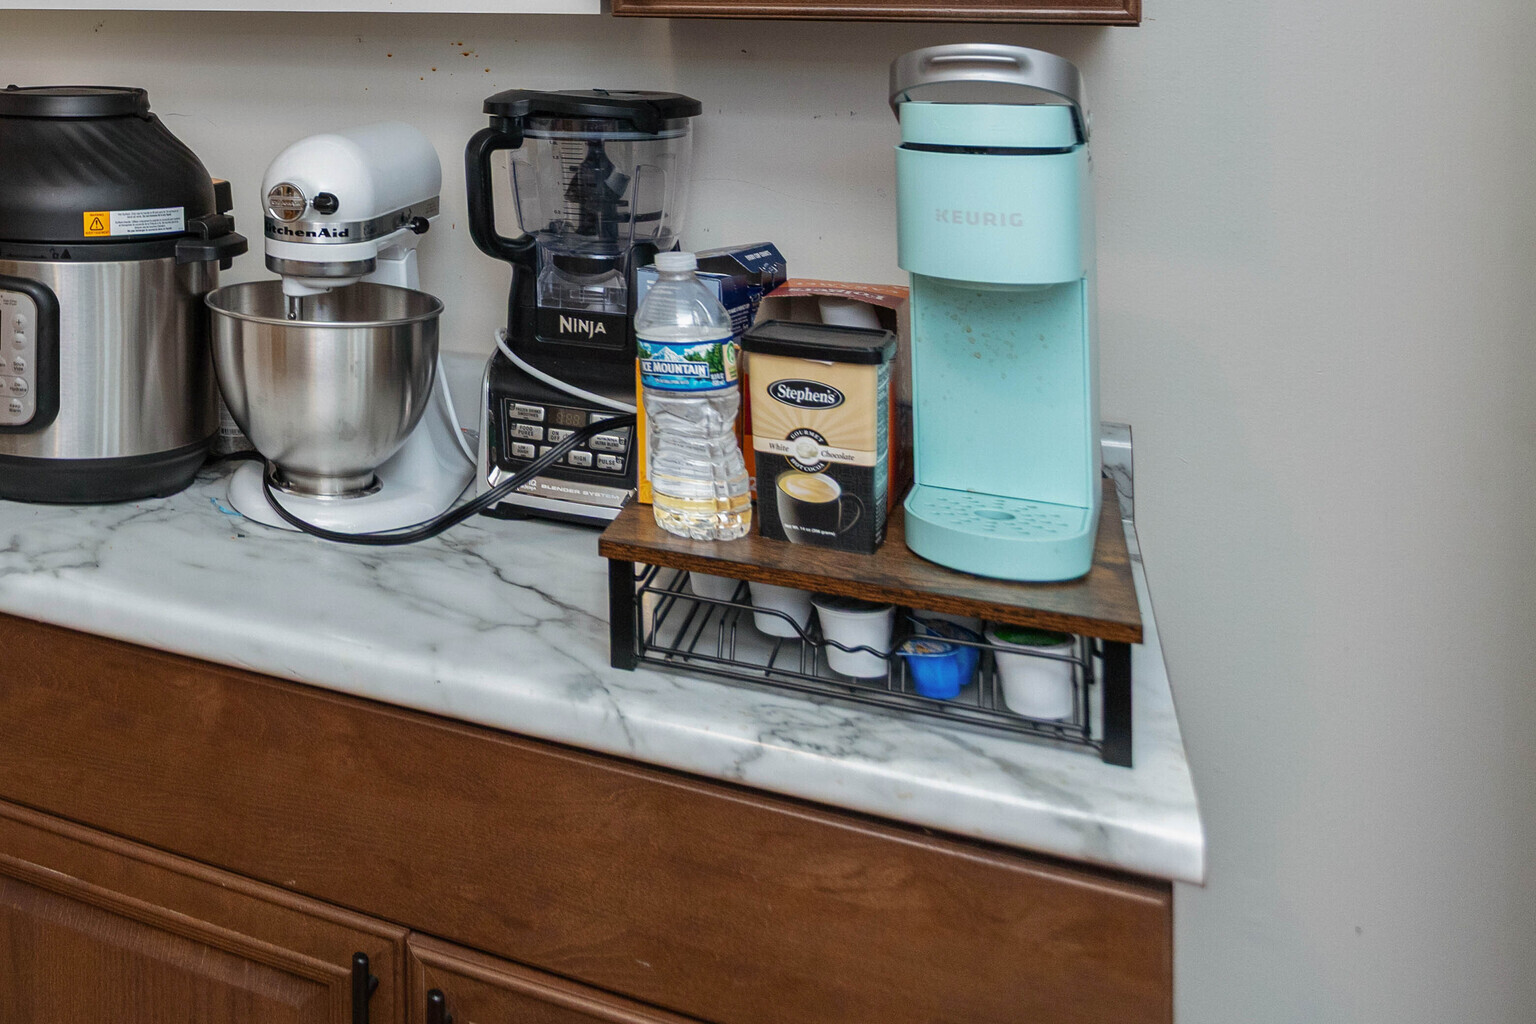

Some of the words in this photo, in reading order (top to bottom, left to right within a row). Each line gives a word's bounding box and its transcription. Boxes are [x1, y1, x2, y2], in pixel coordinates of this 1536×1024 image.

[935, 208, 1024, 226] KEURIG
[559, 314, 607, 340] NINJA
[653, 361, 707, 377] MOUNTAIN
[777, 384, 837, 404] Stephen's
[791, 429, 824, 443] GOURMET
[769, 442, 790, 452] White
[820, 450, 855, 461] Chocolate
[791, 458, 804, 470] HOT
[804, 462, 825, 473] COCOA
[541, 484, 581, 494] BLENDER
[583, 490, 619, 499] SYSTEM
